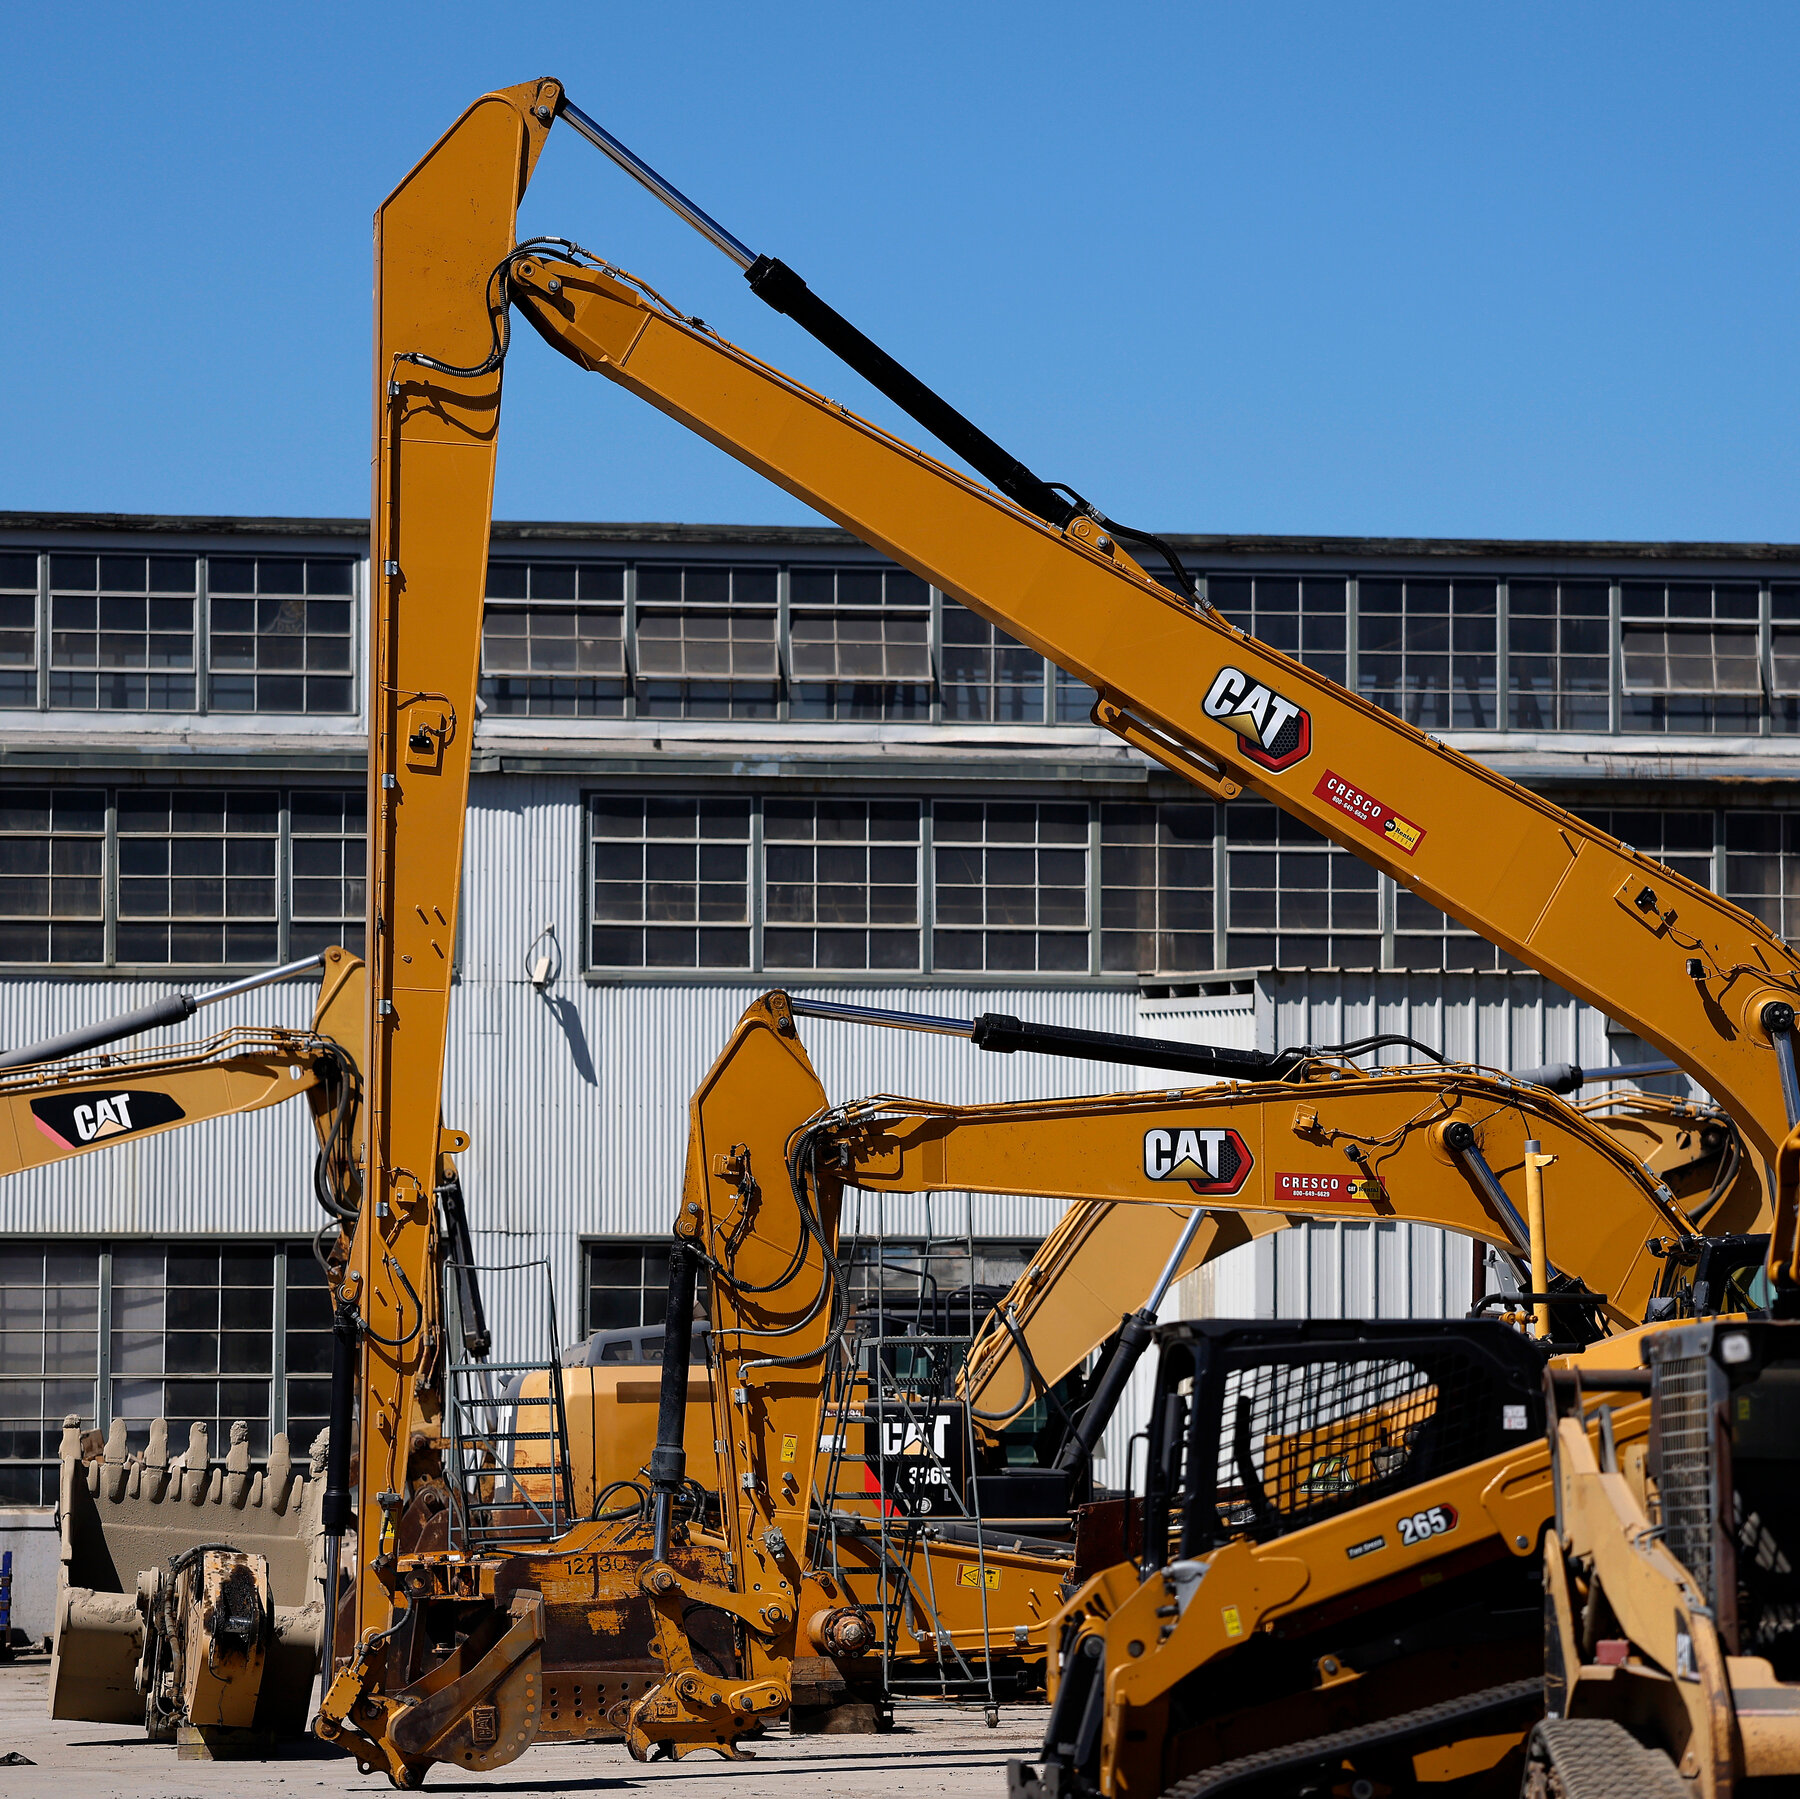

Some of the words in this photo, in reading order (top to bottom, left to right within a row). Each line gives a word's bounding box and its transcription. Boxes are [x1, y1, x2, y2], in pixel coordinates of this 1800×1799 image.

[1204, 667, 1300, 750] CAT
[1327, 778, 1382, 817] CRESCO
[1395, 827, 1415, 843] Rental
[73, 1093, 132, 1141] CAT
[1145, 1130, 1226, 1179] CAT
[1282, 1176, 1339, 1190] CRESCO
[882, 1414, 951, 1459] CAT
[908, 1466, 952, 1485] 336E
[944, 1488, 952, 1502] L
[1397, 1506, 1447, 1546] 265
[564, 1556, 627, 1576] 12230
